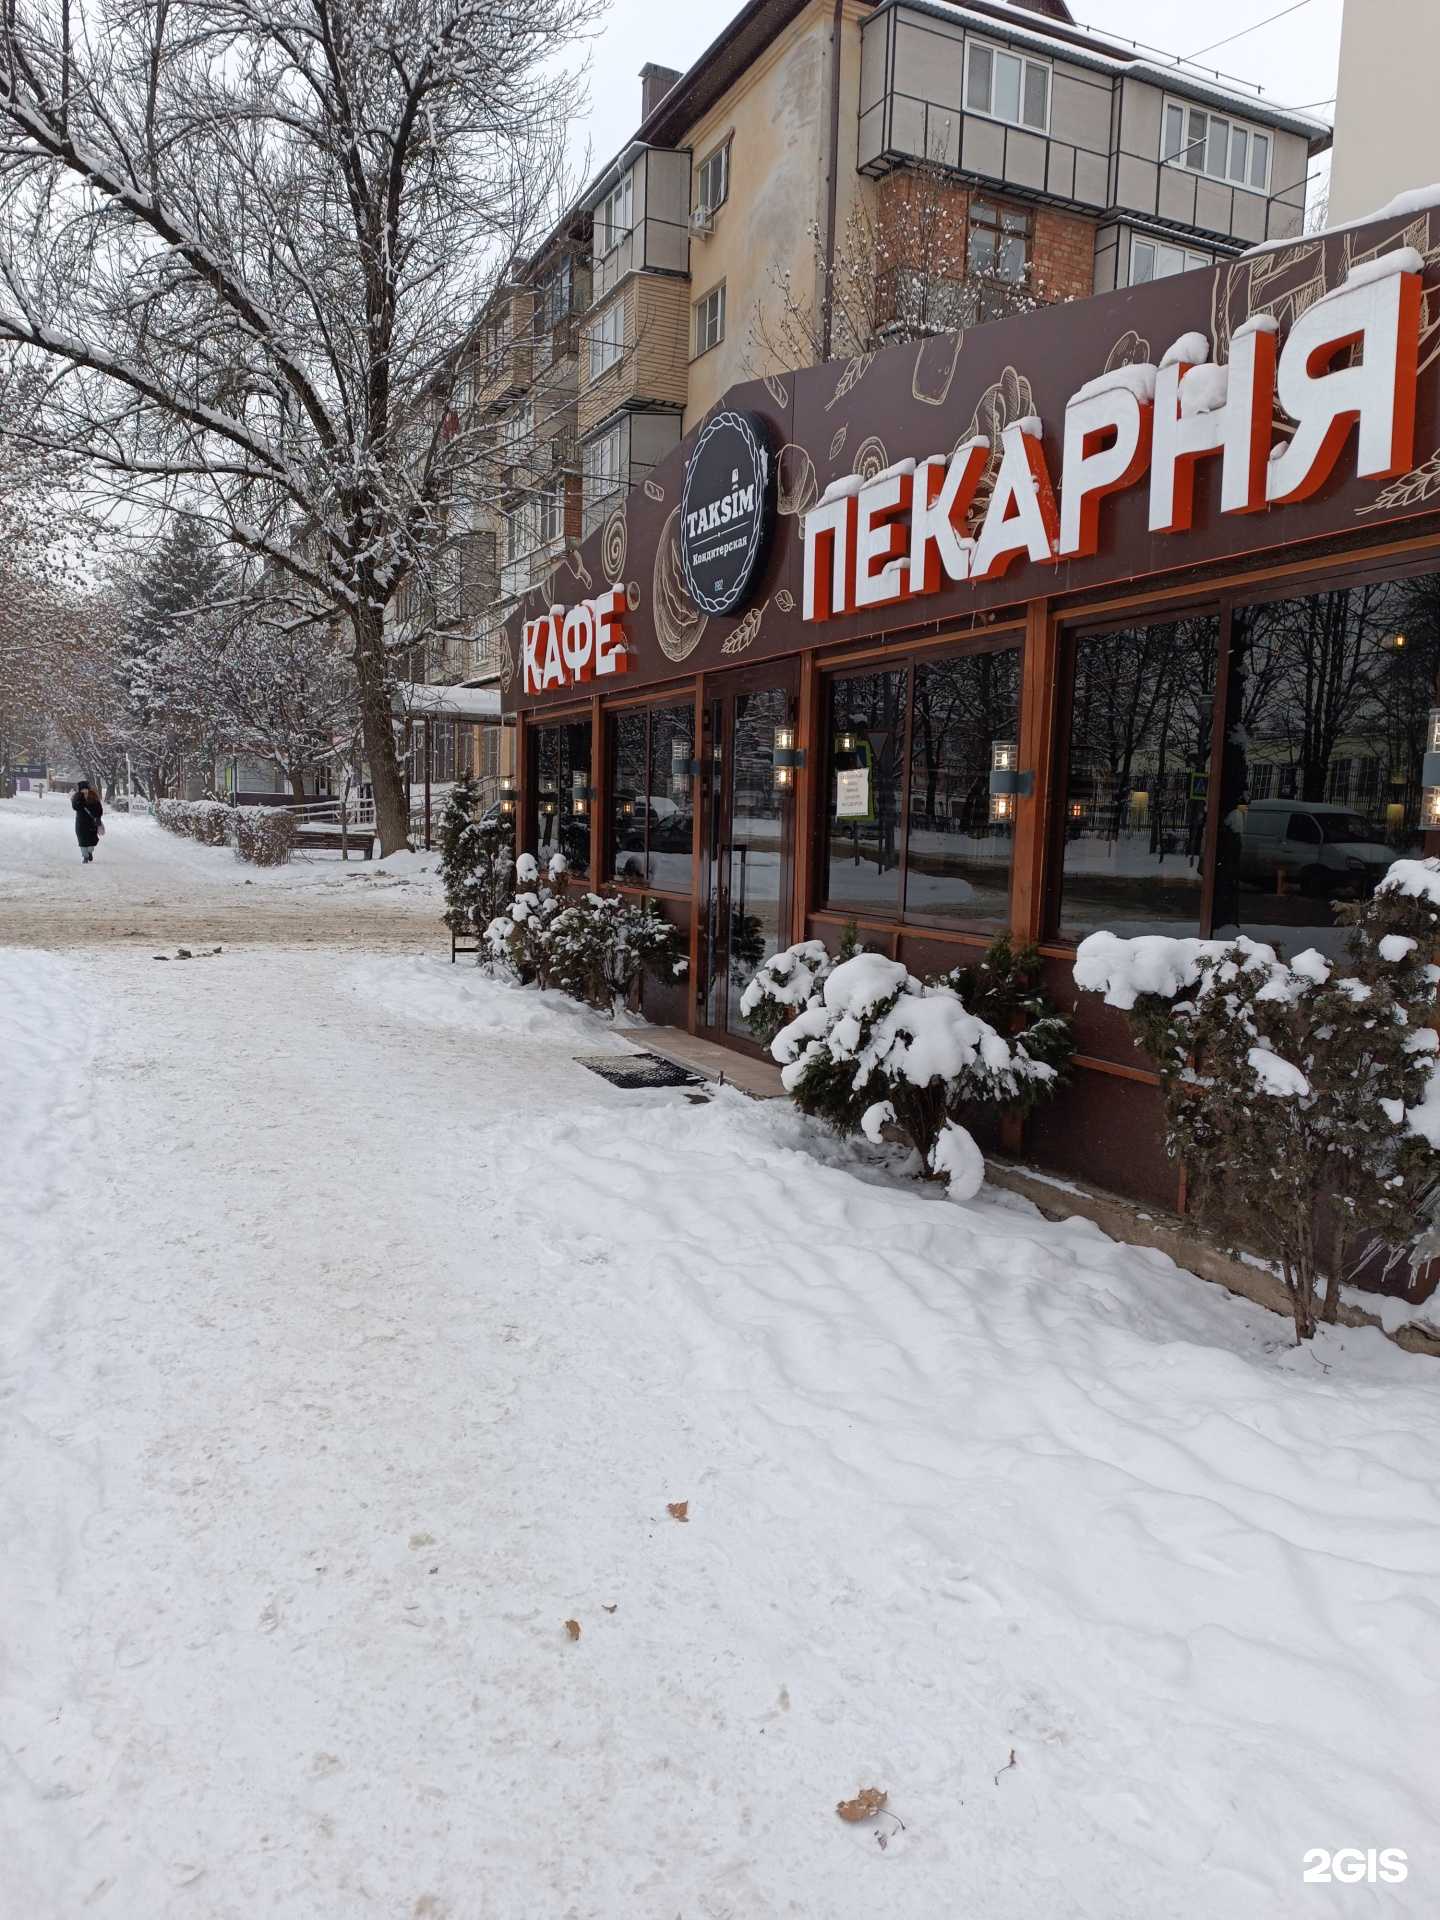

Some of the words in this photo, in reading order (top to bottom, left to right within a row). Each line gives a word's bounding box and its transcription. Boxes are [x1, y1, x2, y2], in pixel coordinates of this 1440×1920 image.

[802, 262, 1422, 622] ПЕКАРНЯ
[692, 535, 748, 566] Кондитерская
[523, 588, 628, 696] КАФЕ
